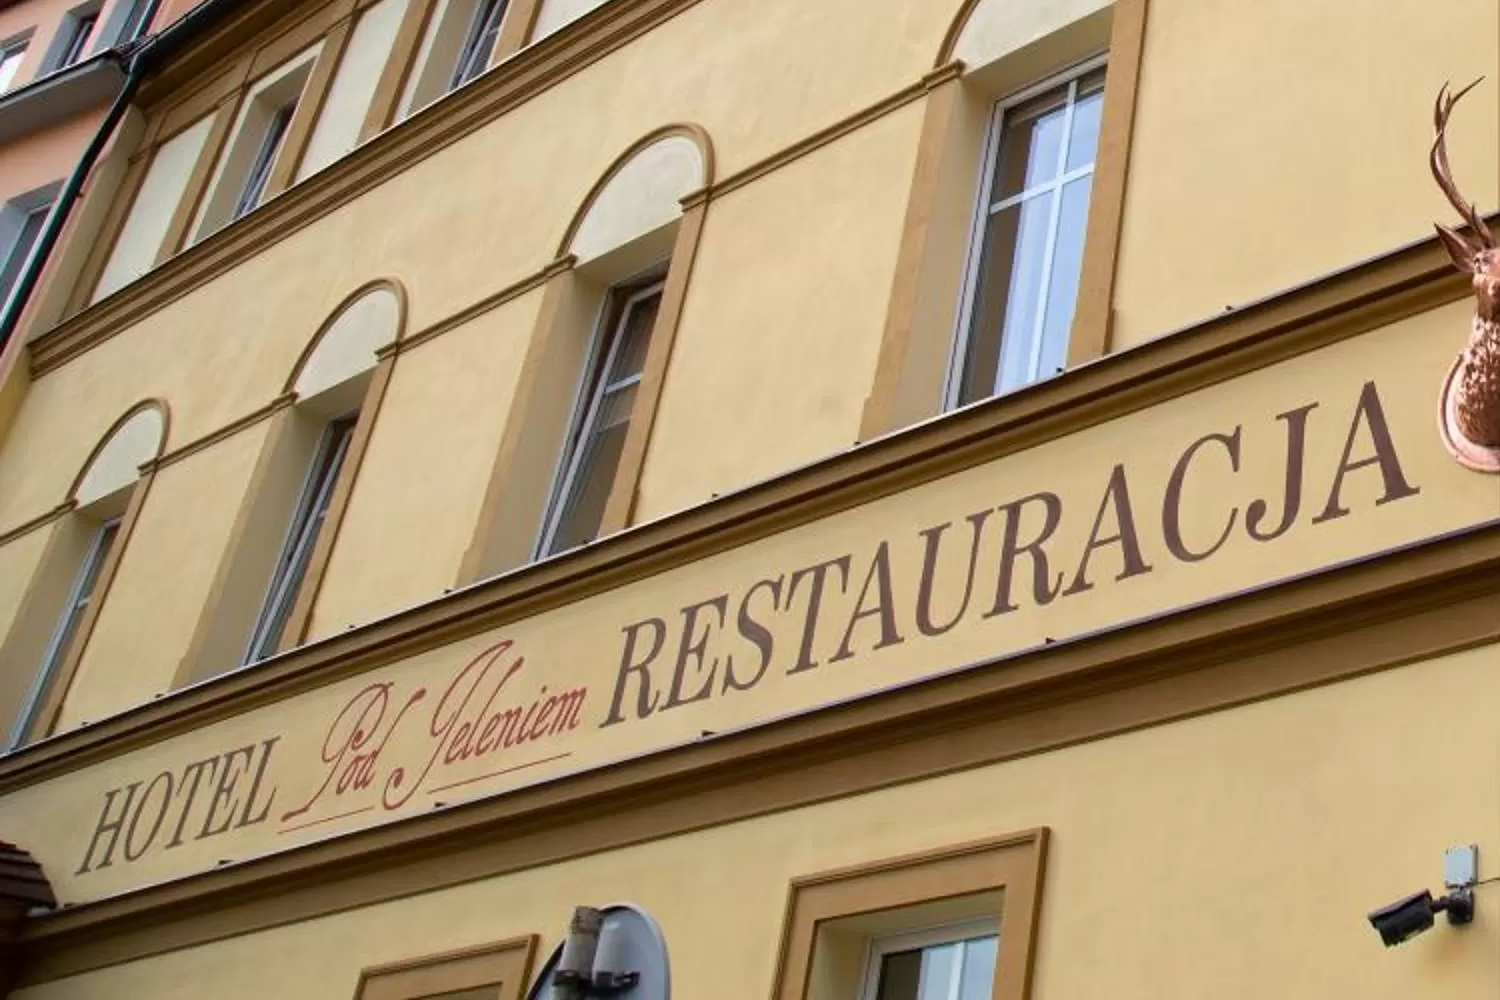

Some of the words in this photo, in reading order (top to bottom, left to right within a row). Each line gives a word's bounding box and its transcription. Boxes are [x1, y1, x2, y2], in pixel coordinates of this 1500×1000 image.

[74, 735, 281, 875] HOTEL
[280, 680, 426, 822] Pod
[381, 638, 588, 811] Jeleniem
[598, 380, 1420, 729] RESTAURACJA
